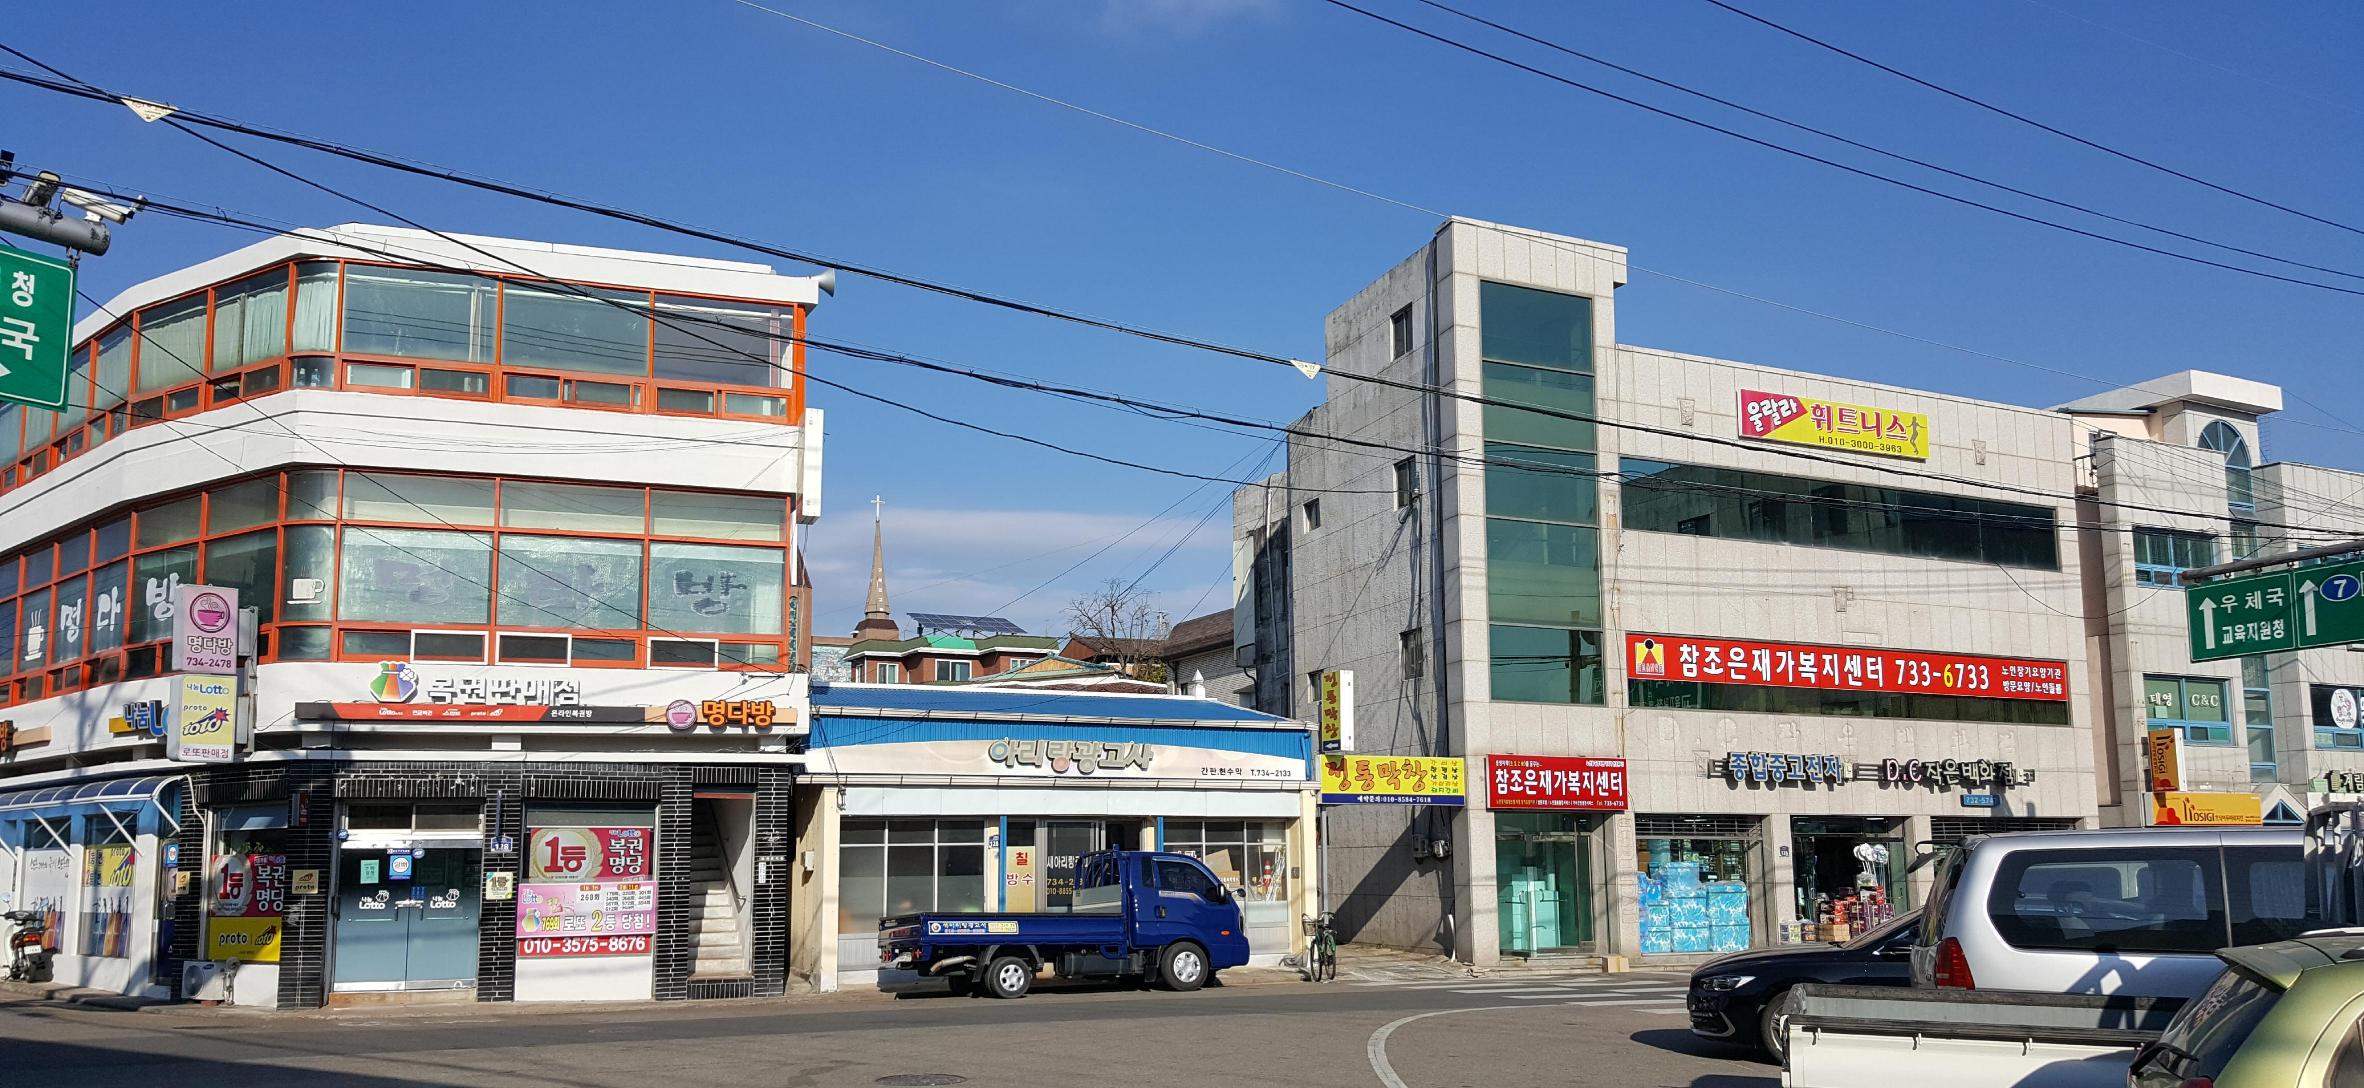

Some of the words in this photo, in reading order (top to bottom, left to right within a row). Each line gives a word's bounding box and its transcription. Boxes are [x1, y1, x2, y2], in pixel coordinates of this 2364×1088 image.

[1747, 398, 1798, 433] 울랄라
[1810, 403, 1909, 442] 휘트니스
[2333, 579, 2348, 598] 7
[2219, 587, 2285, 613] 우체국
[2221, 619, 2285, 645] 교육지원청
[186, 635, 234, 656] 명다방
[186, 656, 232, 669] 734-2478
[1679, 643, 1884, 688] 참조은재가복지센터
[1895, 659, 1990, 690] 733-6733
[2001, 665, 2062, 680] 노인장기요양기관
[199, 684, 230, 695] Lotto
[427, 677, 581, 706] 복권판매점
[2149, 692, 2172, 707] 태영
[2191, 693, 2219, 707] C&C
[551, 708, 593, 719] 온라인복권방
[702, 699, 776, 728] 명다방
[181, 747, 230, 759] 로또판매점
[988, 736, 1154, 774] 아리랑광고사
[1201, 767, 1243, 778] 간판.현수막
[1250, 768, 1292, 778] T.734-2133
[1729, 751, 1843, 784] 종합중고전자
[1495, 768, 1623, 797] 참조은재가복지센터
[543, 837, 587, 873] 1등
[608, 838, 643, 857] 복권
[608, 857, 644, 874] 명당
[1016, 851, 1028, 866] 칠
[218, 863, 244, 900] 1등
[256, 865, 286, 888] 복권
[1006, 873, 1034, 886] 방수
[359, 901, 386, 910] Lotto
[430, 900, 456, 909] Lotto
[563, 915, 587, 931] 로또
[591, 909, 616, 932] 2등
[622, 913, 650, 930] 당첨!
[218, 932, 248, 947] proto
[523, 936, 646, 954] 010-3575-8676
